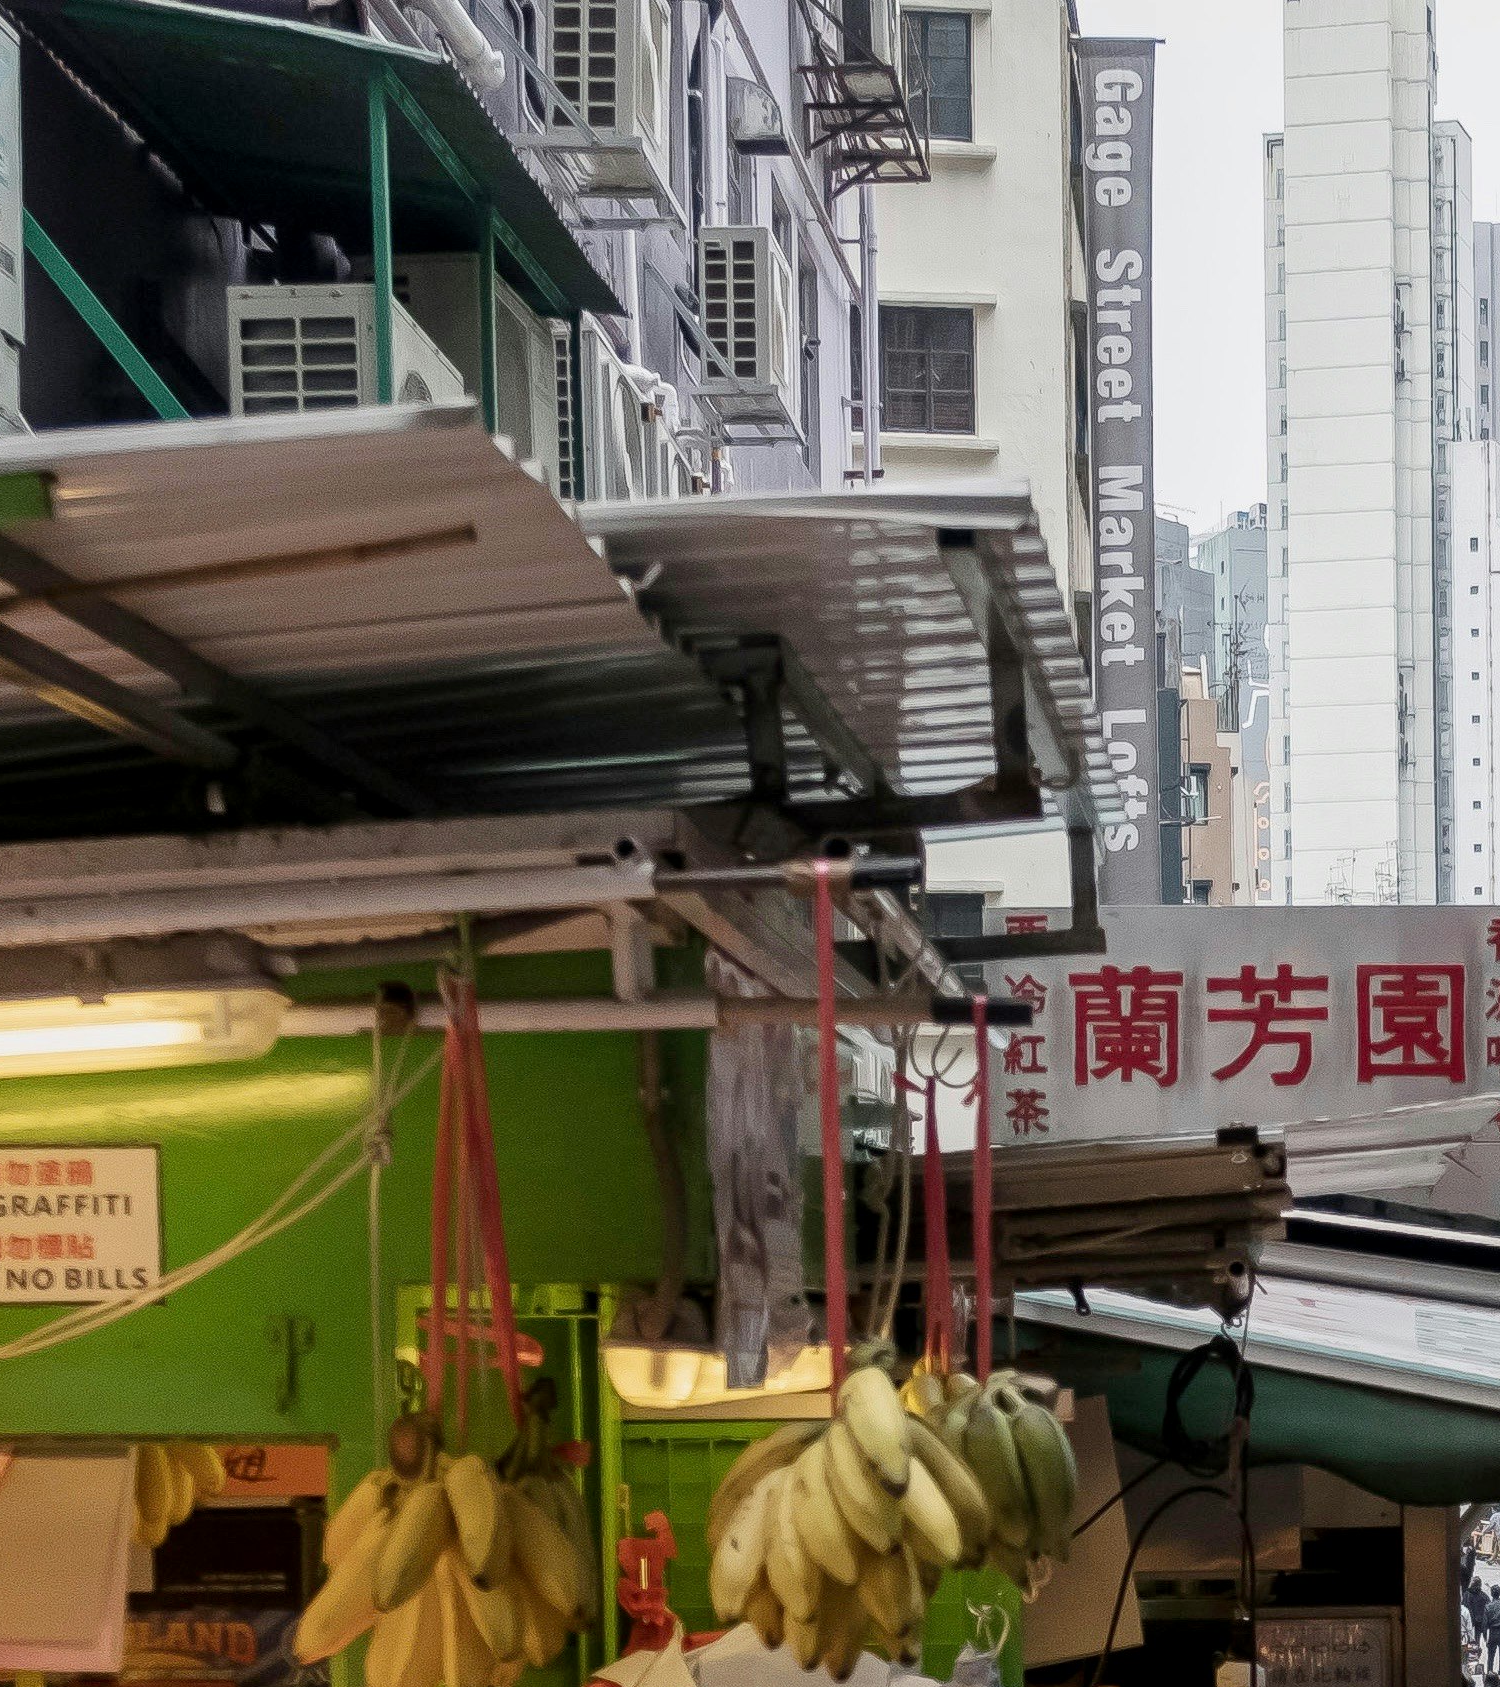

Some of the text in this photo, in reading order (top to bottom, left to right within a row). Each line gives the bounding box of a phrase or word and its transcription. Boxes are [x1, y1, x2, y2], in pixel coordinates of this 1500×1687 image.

[1085, 69, 1149, 853] Gage Street Market Lofts
[1068, 964, 1466, 1087] 蘭芳園
[5, 1268, 55, 1292] NO
[63, 1267, 150, 1292] BILLS
